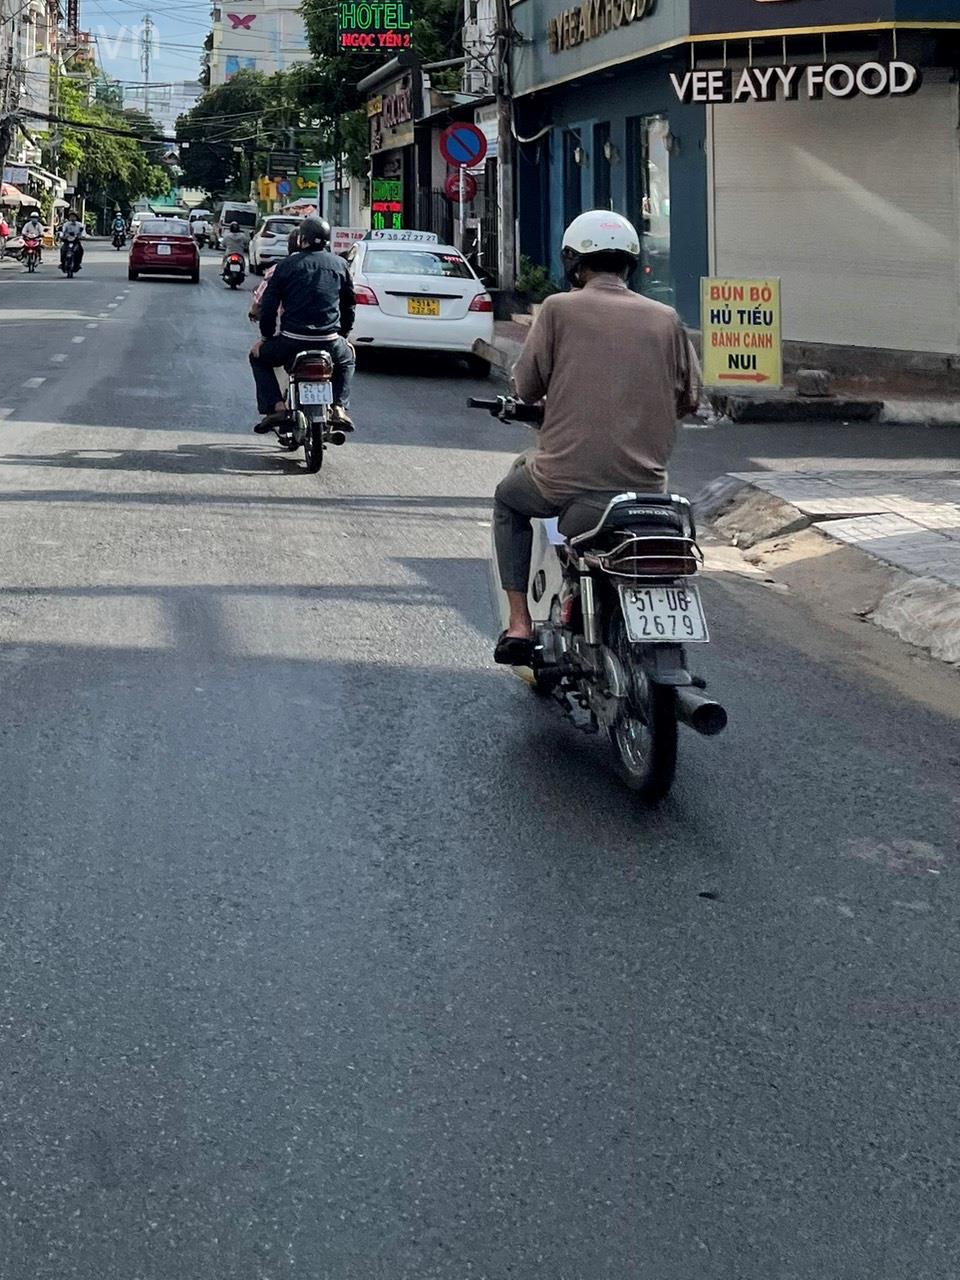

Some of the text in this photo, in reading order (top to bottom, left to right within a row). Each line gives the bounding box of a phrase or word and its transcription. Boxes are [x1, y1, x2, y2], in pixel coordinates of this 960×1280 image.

[342, 3, 410, 29] HOTEL
[341, 30, 410, 49] NGỌC YẾN 2
[669, 61, 917, 101] VEE AYY FOOD
[710, 282, 772, 302] BÚN BÒ
[710, 304, 773, 326] HỦ TIẾU
[711, 327, 773, 349] BÁNH CANH
[728, 354, 757, 370] NUI
[639, 615, 694, 636] 2679
